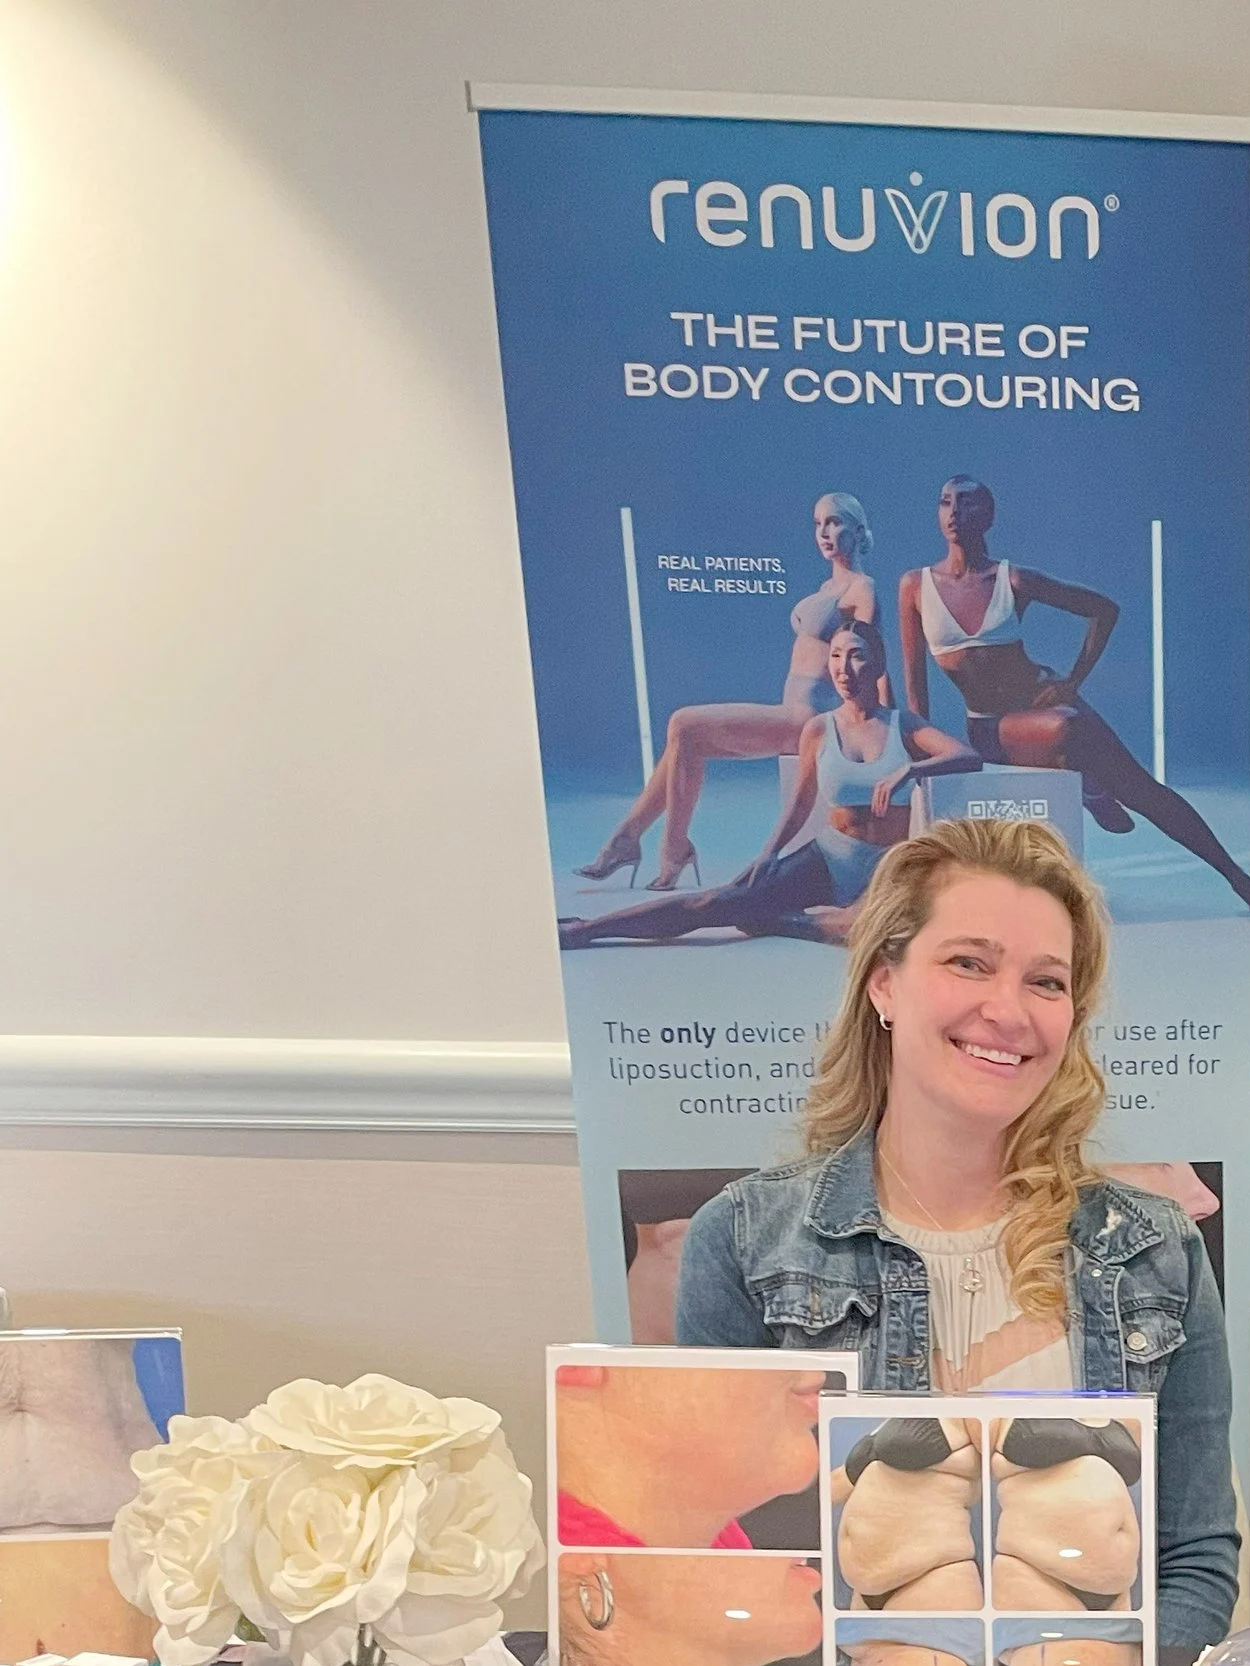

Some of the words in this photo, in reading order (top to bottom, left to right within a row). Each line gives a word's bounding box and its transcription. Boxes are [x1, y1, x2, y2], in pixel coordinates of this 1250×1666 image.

[670, 311, 780, 350] THE
[793, 316, 1006, 357] FUTURE
[1018, 324, 1090, 359] OF
[623, 362, 770, 401] BODY
[784, 368, 1140, 412] CONTOURING
[657, 555, 701, 571] REAL
[704, 556, 786, 574] PATIENTS,
[667, 577, 710, 593] REAL
[714, 578, 787, 595] RESULTS
[602, 1021, 651, 1044] The
[660, 1021, 716, 1048] only
[725, 1021, 805, 1044] device
[1114, 1025, 1157, 1041] use
[1165, 1019, 1223, 1041] after
[609, 1058, 760, 1086] liposuction,
[770, 1057, 816, 1079] and
[1096, 1054, 1178, 1076] leared
[1188, 1053, 1221, 1075] for
[679, 1093, 808, 1115] contractin
[1104, 1093, 1156, 1110] sue.
